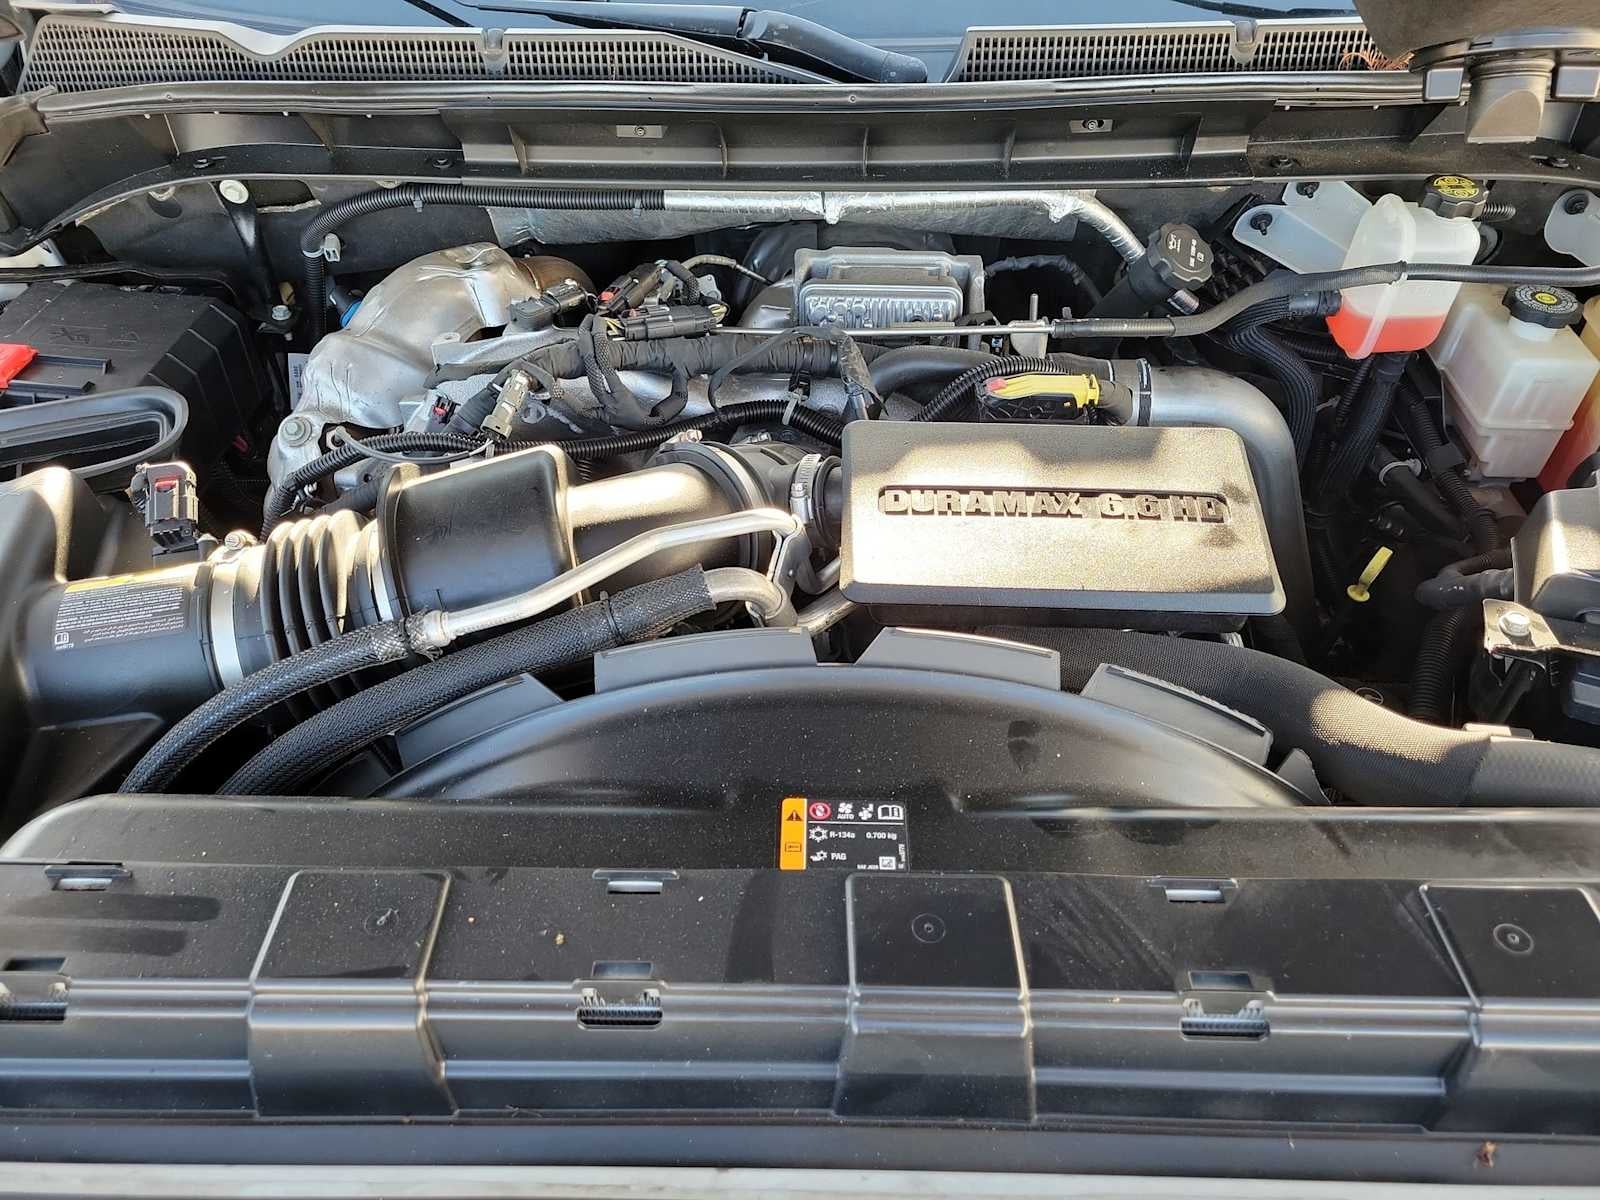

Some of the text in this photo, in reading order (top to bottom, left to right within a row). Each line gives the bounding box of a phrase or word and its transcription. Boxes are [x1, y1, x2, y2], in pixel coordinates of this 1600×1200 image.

[882, 489, 1225, 523] DURAMAX 6.6 HD
[829, 830, 898, 841] R-134a 0.700 kg
[830, 852, 847, 861] PAG
